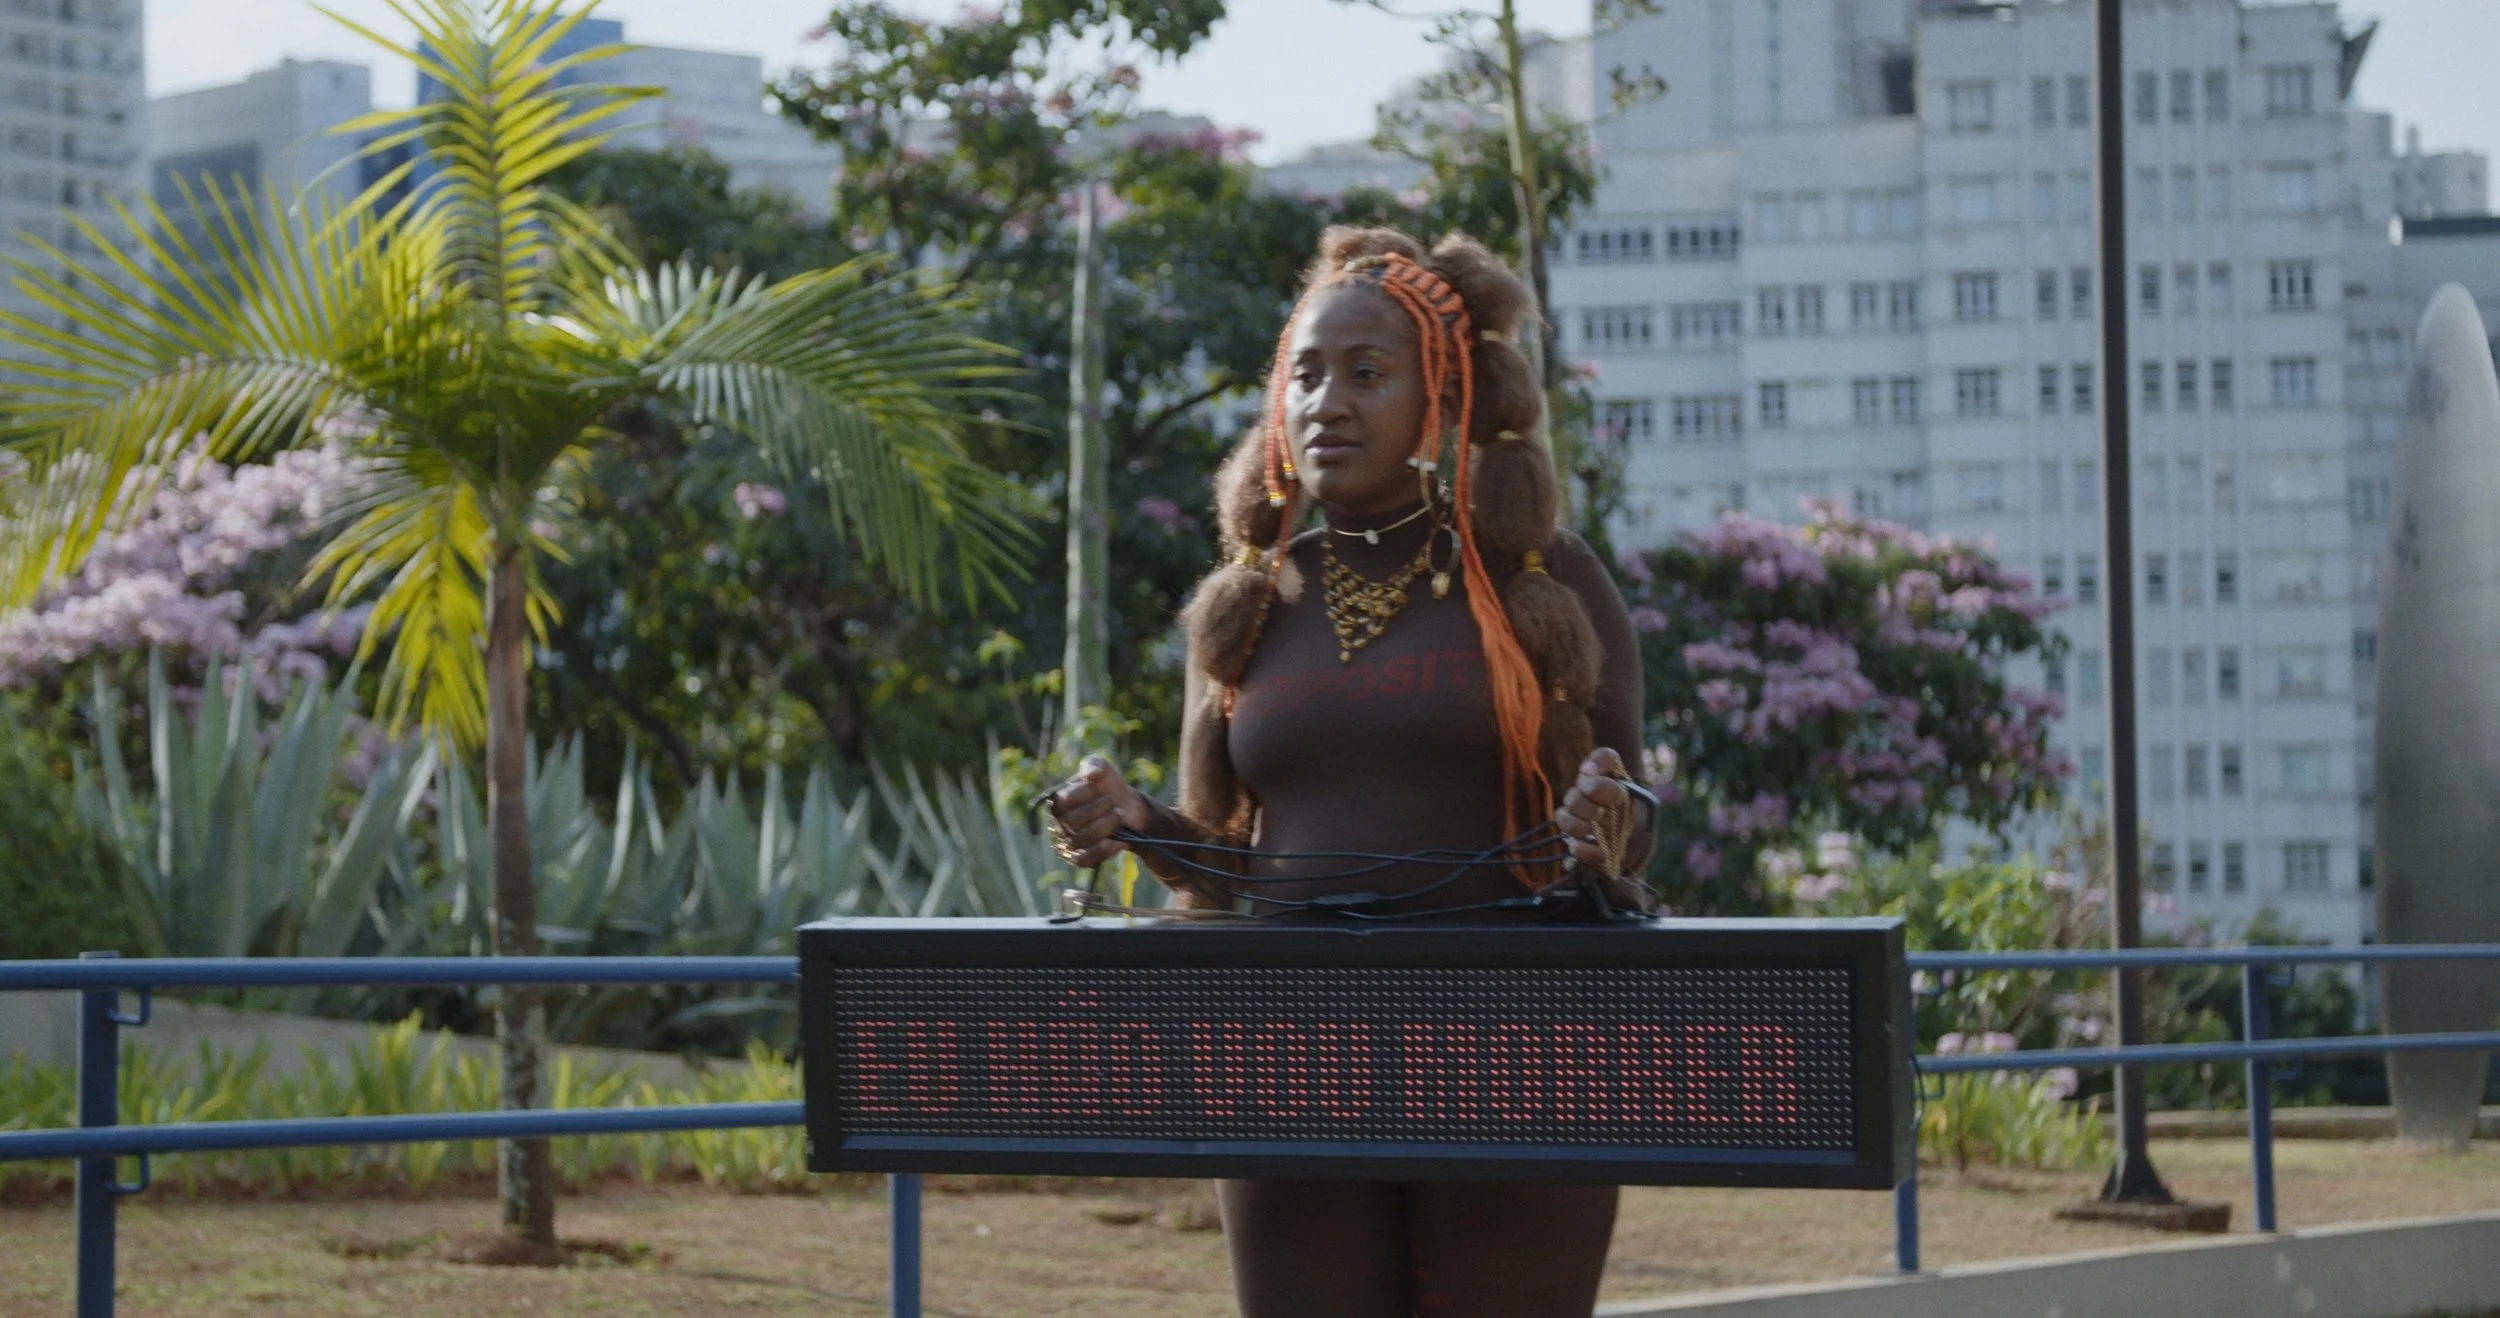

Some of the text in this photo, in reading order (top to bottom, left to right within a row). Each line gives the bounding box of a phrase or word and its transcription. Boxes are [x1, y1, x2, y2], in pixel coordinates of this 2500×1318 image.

[856, 1020, 958, 1112] EU
[1192, 1022, 1371, 1118] VOU
[1403, 1023, 1797, 1124] MORRER
